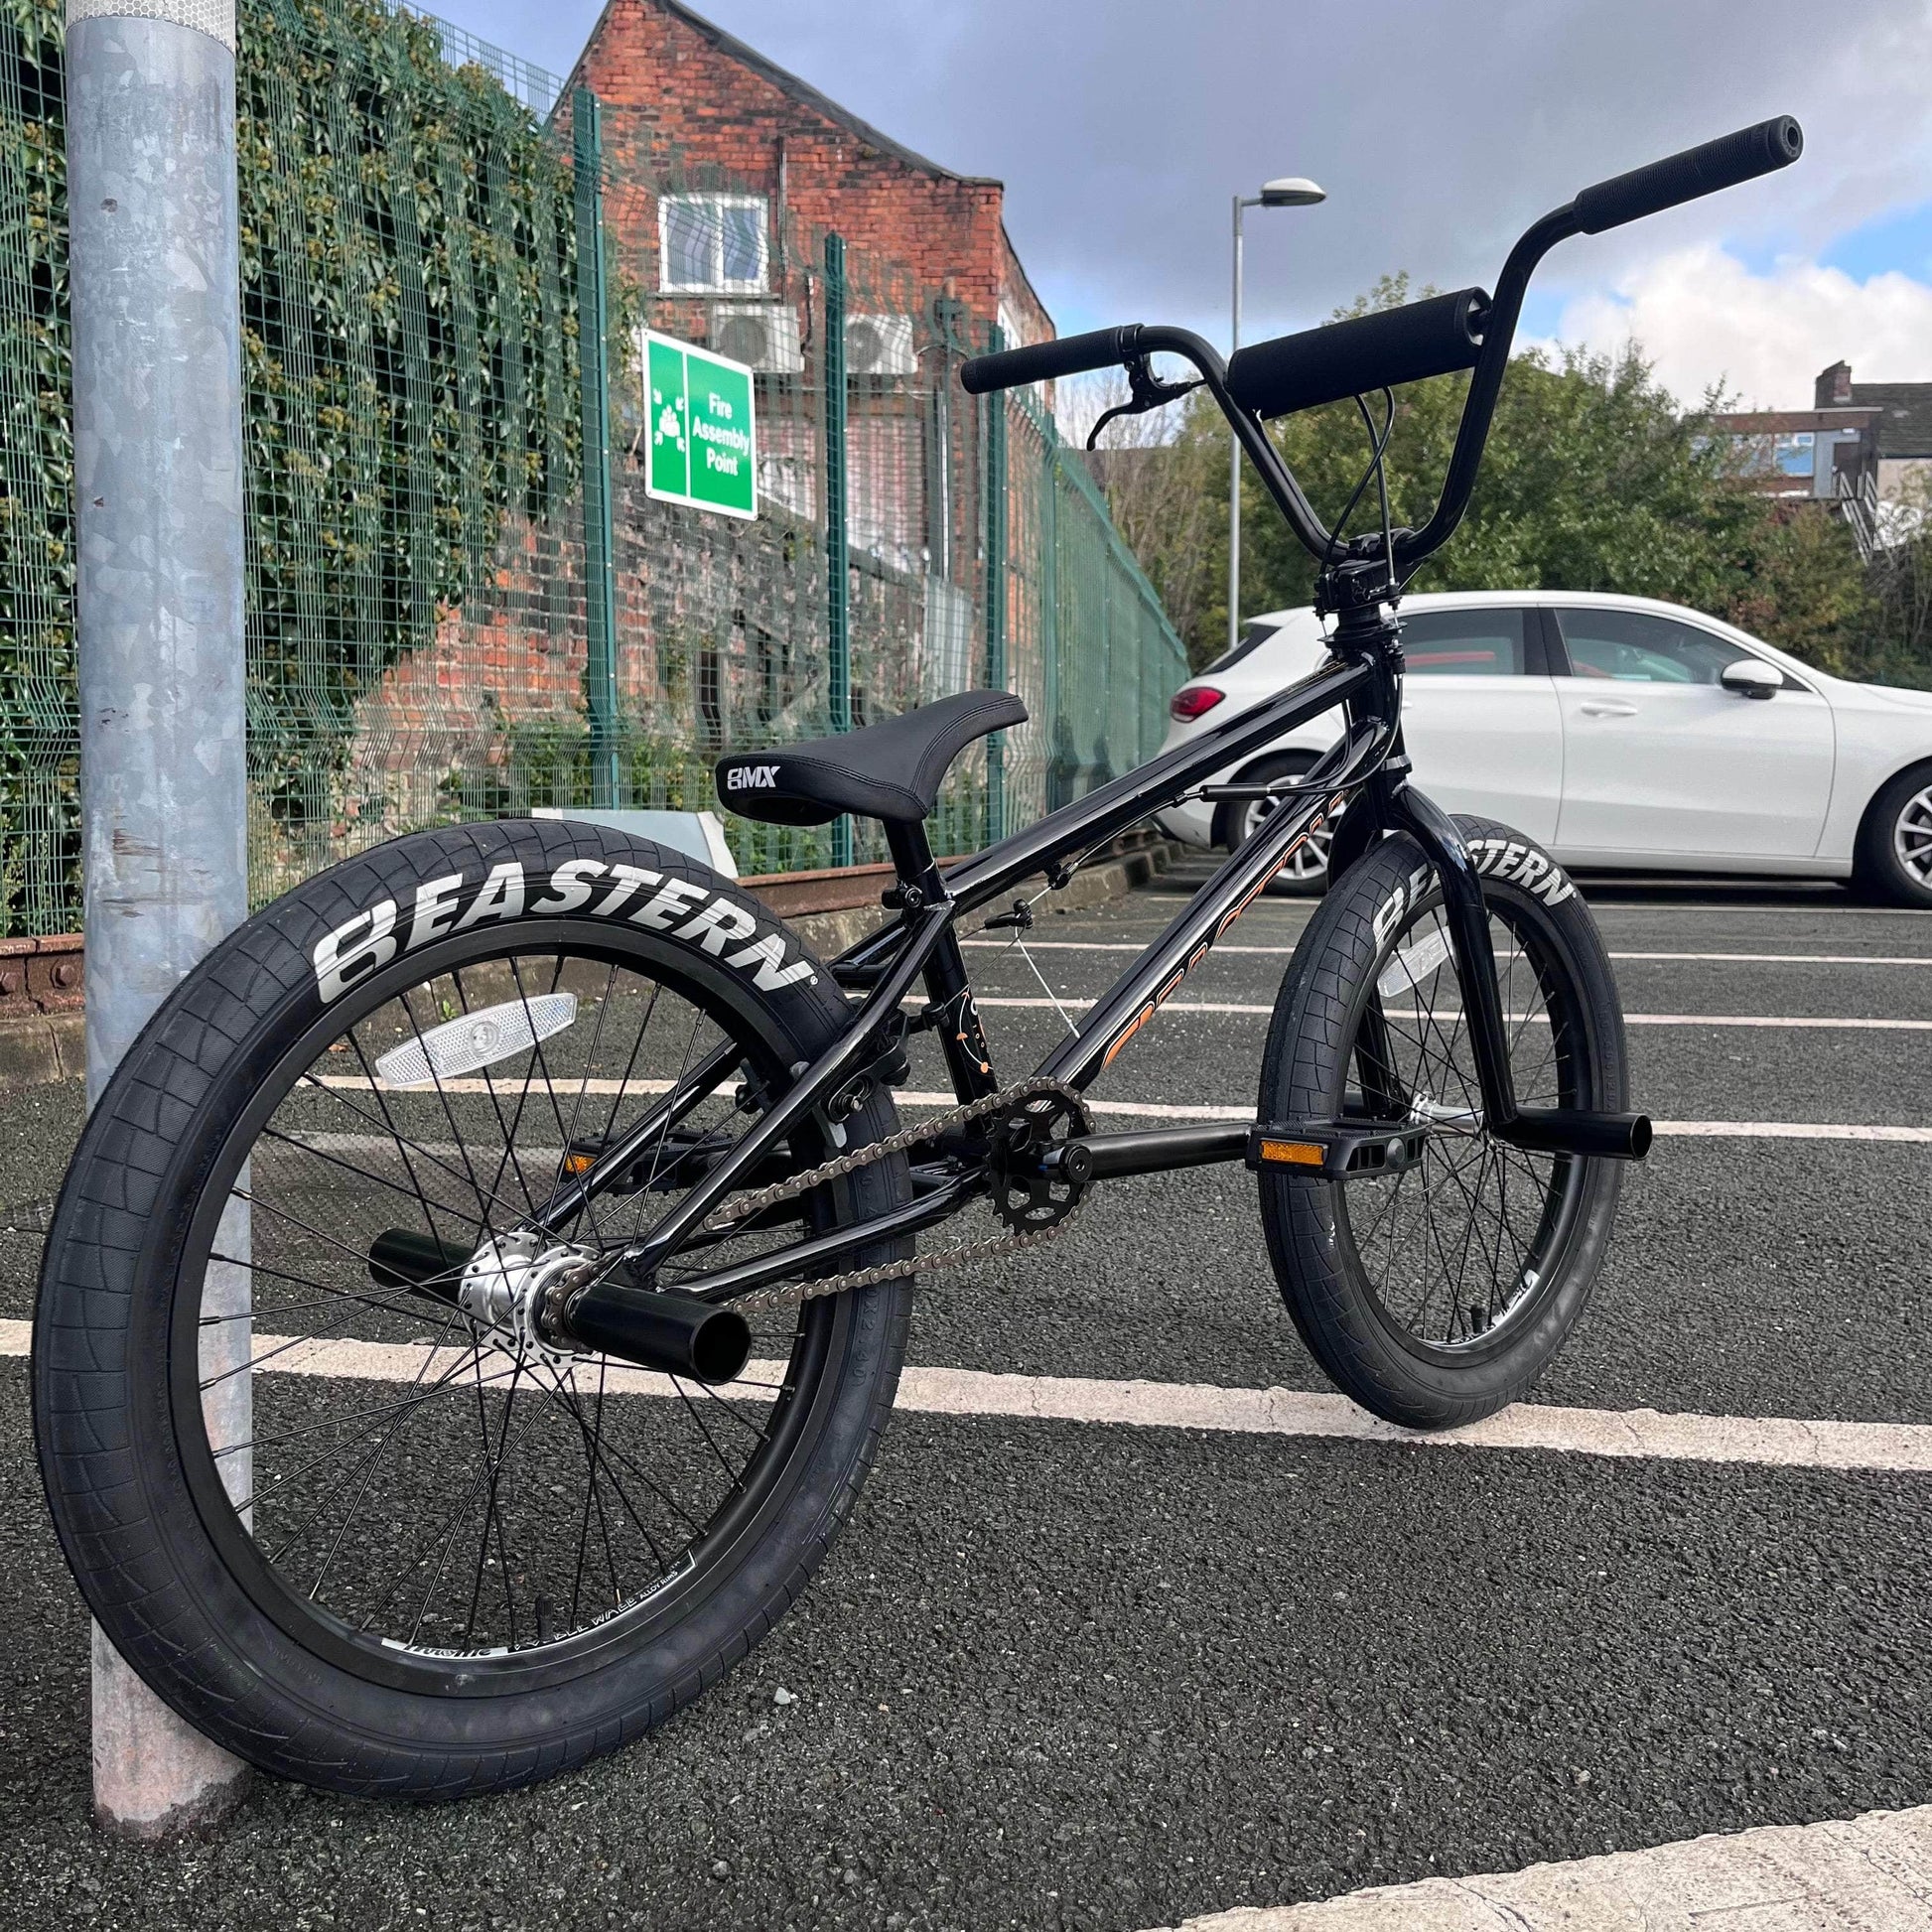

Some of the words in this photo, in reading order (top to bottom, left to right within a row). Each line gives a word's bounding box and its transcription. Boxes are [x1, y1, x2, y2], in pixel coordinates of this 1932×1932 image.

[709, 392, 733, 419] Fire
[693, 416, 751, 457] Assembly
[706, 447, 739, 477] Point
[639, 1583, 660, 1599] ALLOY
